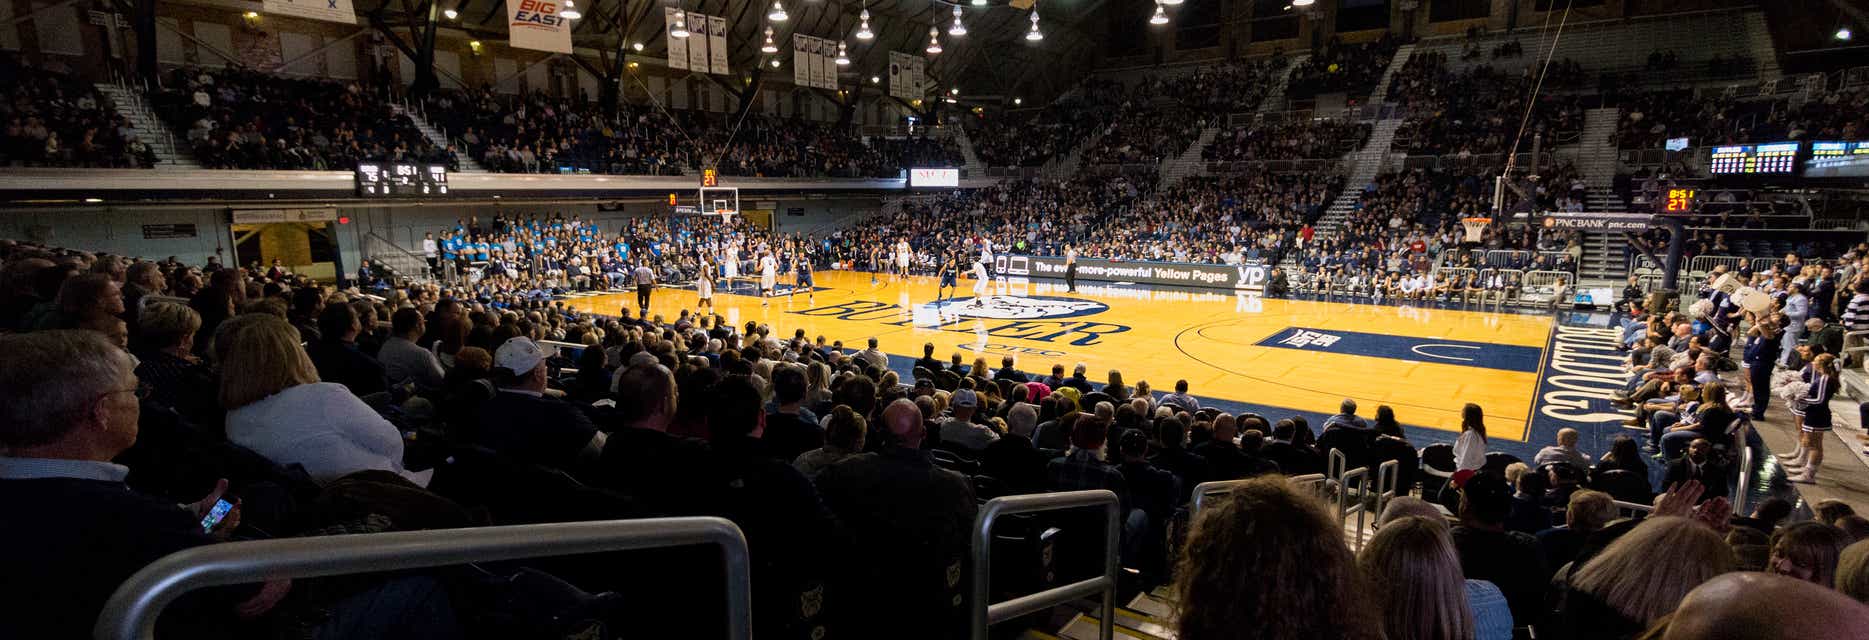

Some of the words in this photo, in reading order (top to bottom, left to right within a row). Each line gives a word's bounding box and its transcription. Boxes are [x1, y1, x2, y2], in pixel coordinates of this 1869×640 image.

[520, 0, 556, 14] BIG
[515, 11, 563, 27] EAST
[1669, 189, 1695, 199] 8:51
[1668, 199, 1686, 211] 27
[1607, 221, 1646, 230] pnc.com
[1035, 262, 1051, 273] The
[1053, 264, 1152, 279] ev-more-powerful
[1154, 268, 1191, 281] Yellow
[1192, 270, 1229, 283] Pages
[1237, 266, 1265, 286] yp
[1541, 325, 1638, 423] BULLDOGS
